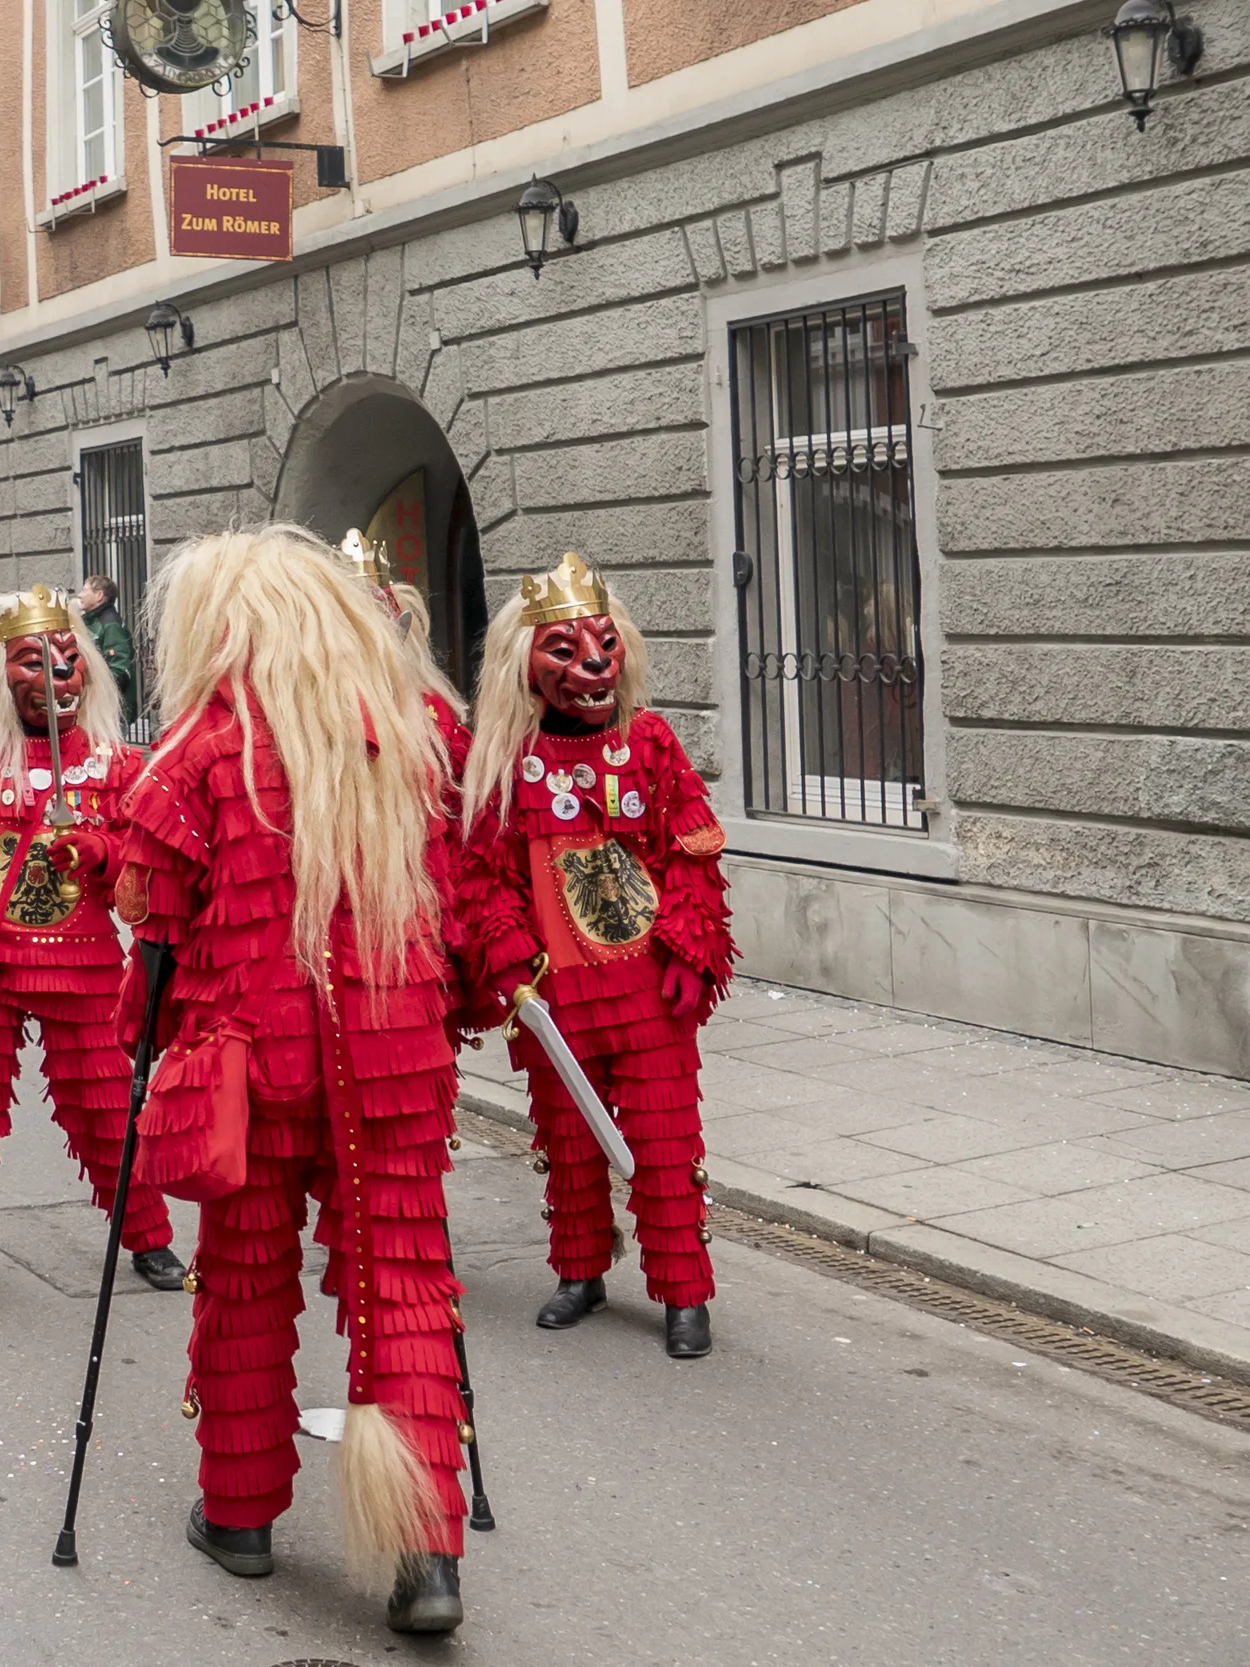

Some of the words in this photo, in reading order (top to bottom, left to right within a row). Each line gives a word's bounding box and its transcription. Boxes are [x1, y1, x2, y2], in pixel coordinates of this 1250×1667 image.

[206, 183, 257, 203] HOTEL
[181, 213, 217, 231] ZUM
[222, 215, 281, 235] RÖMER
